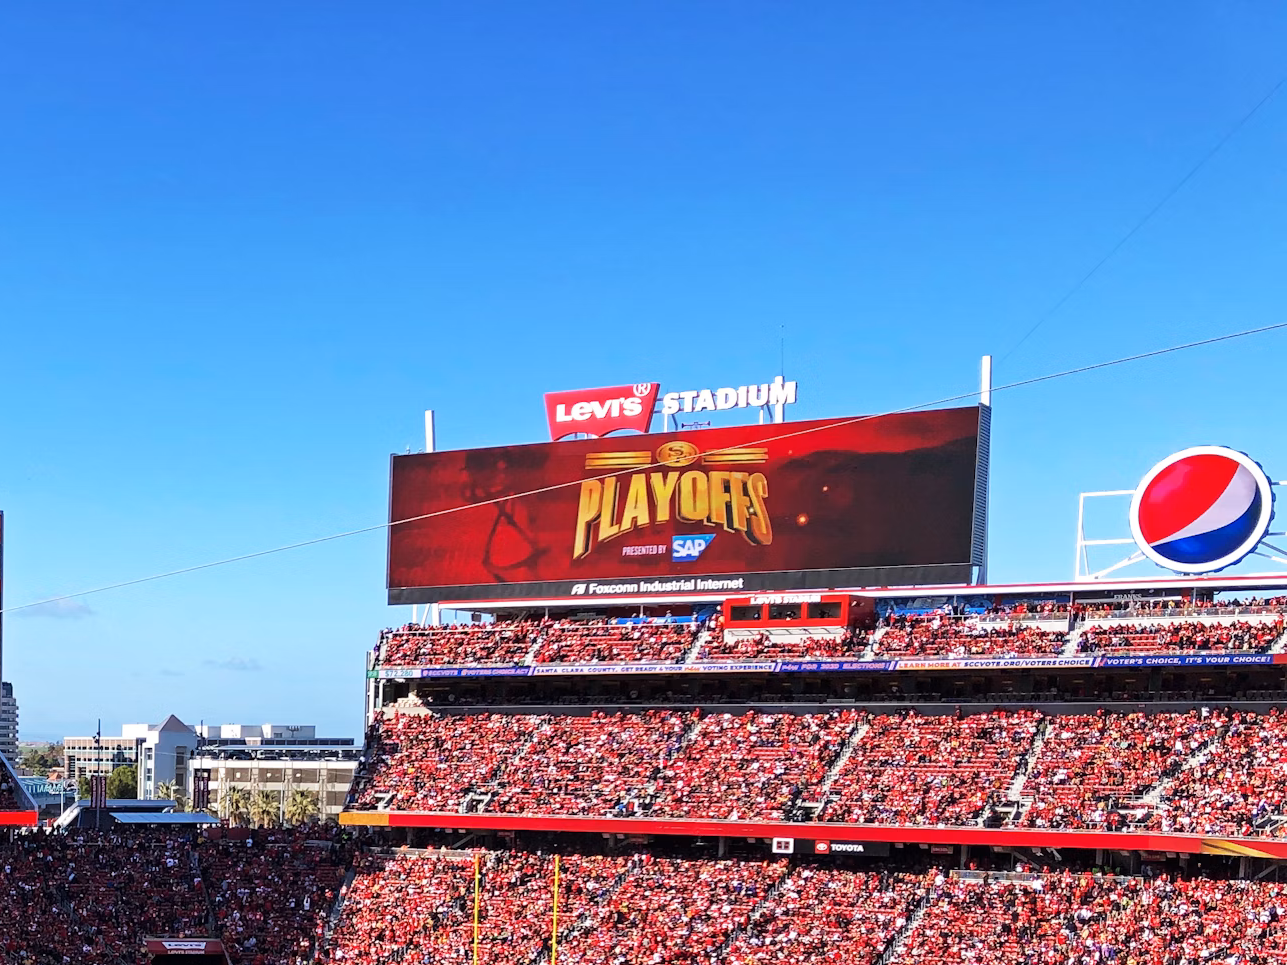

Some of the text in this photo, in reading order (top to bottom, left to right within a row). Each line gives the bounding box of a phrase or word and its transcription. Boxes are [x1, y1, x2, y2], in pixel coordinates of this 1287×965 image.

[662, 381, 798, 415] STADIUM
[573, 470, 773, 560] PLAYOFFS
[622, 544, 667, 556] PRESENTED BY
[671, 536, 707, 558] SAP
[588, 582, 639, 595] Foxconn
[639, 580, 695, 592] Industrial
[696, 578, 745, 590] Internet
[1205, 656, 1231, 664] YOUR
[1233, 656, 1272, 664] CHOICE!
[729, 664, 774, 672] EXPERIENCE
[830, 843, 865, 852] TOYOTA
